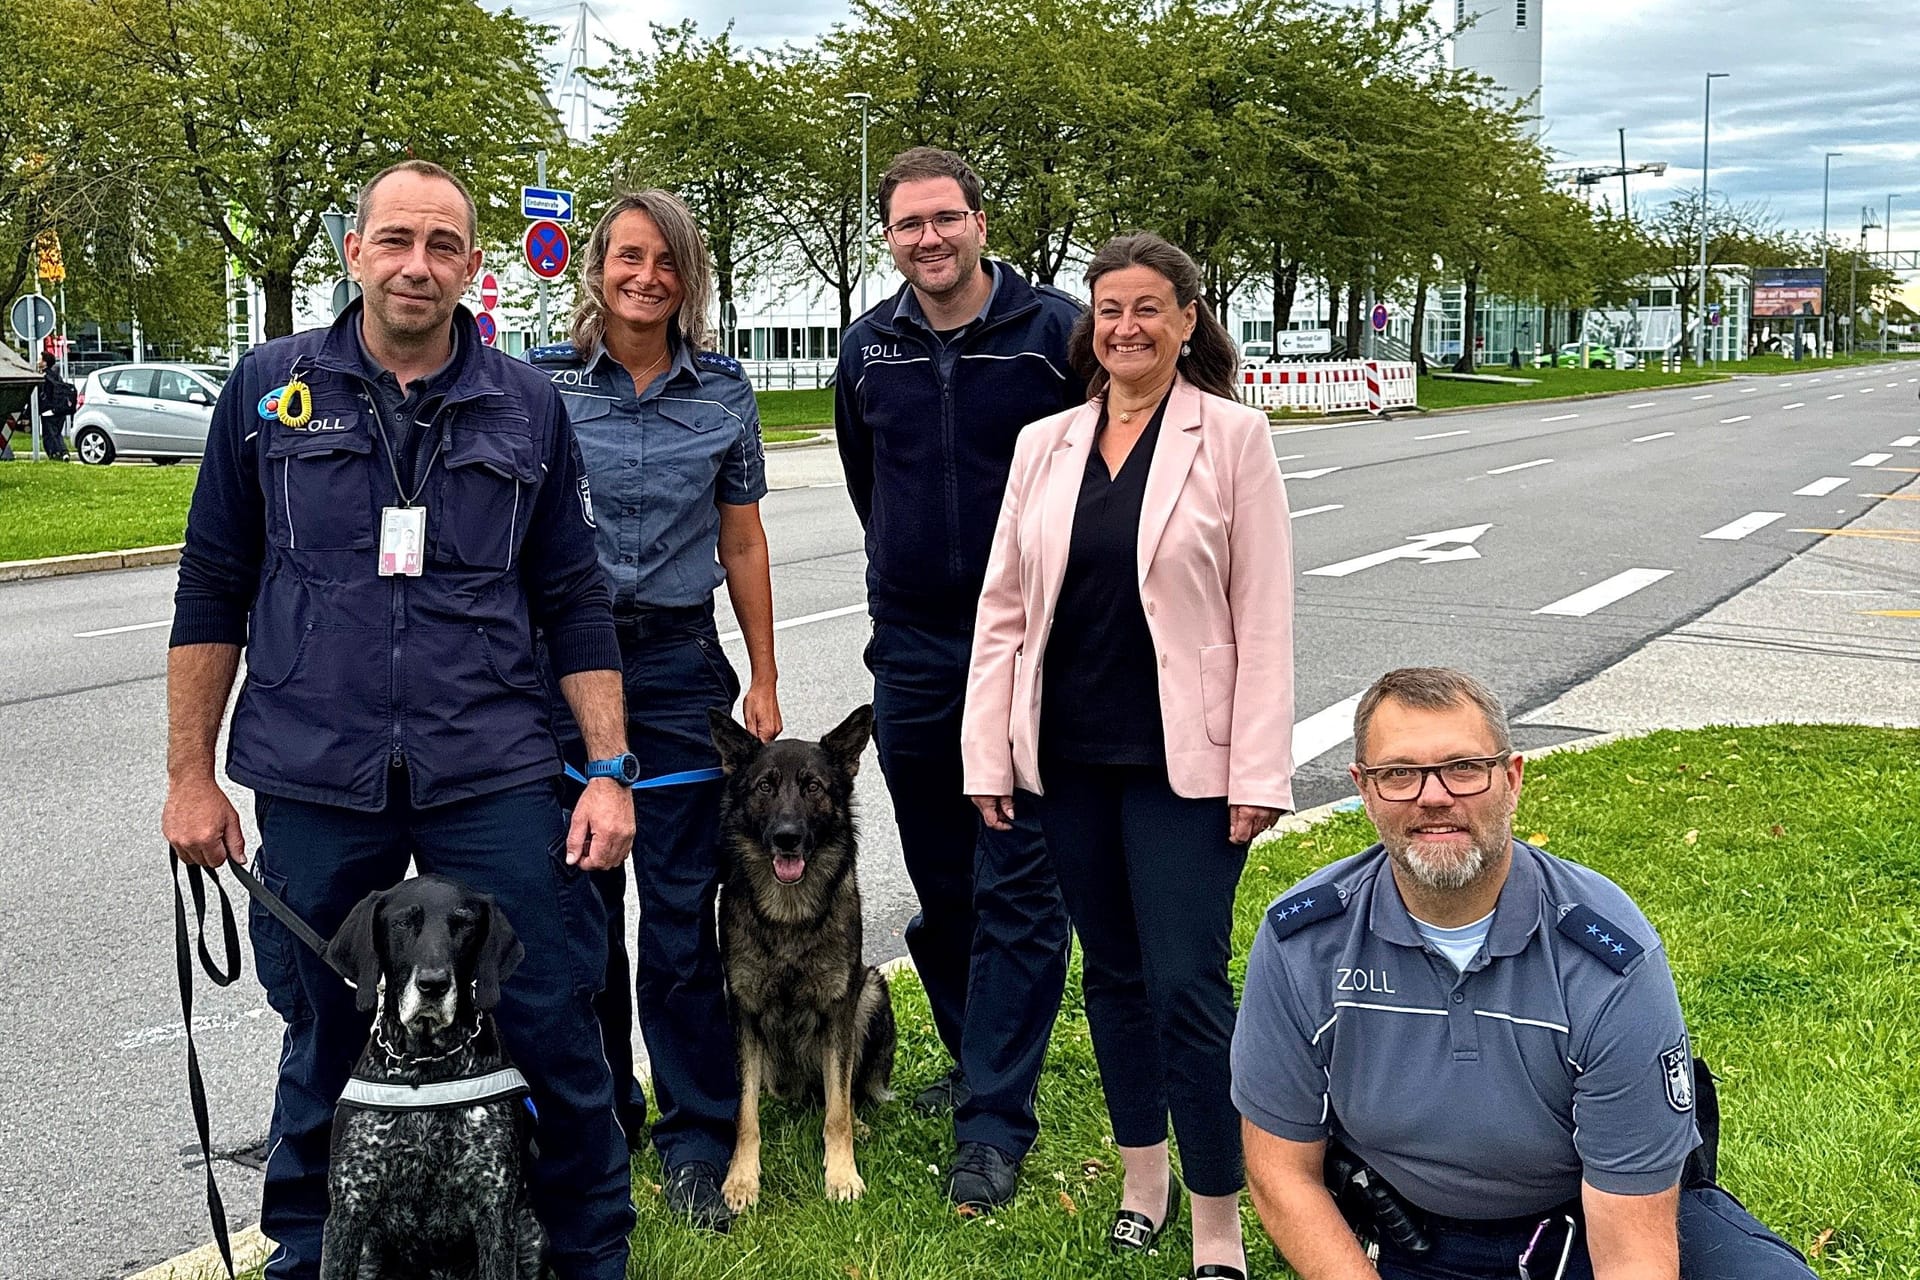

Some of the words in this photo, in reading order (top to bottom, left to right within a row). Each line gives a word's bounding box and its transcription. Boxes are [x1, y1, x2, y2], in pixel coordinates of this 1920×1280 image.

[861, 344, 902, 360] ZOLL
[550, 369, 600, 388] ZOLL
[294, 418, 345, 433] OLL
[1336, 968, 1396, 994] ZOLL
